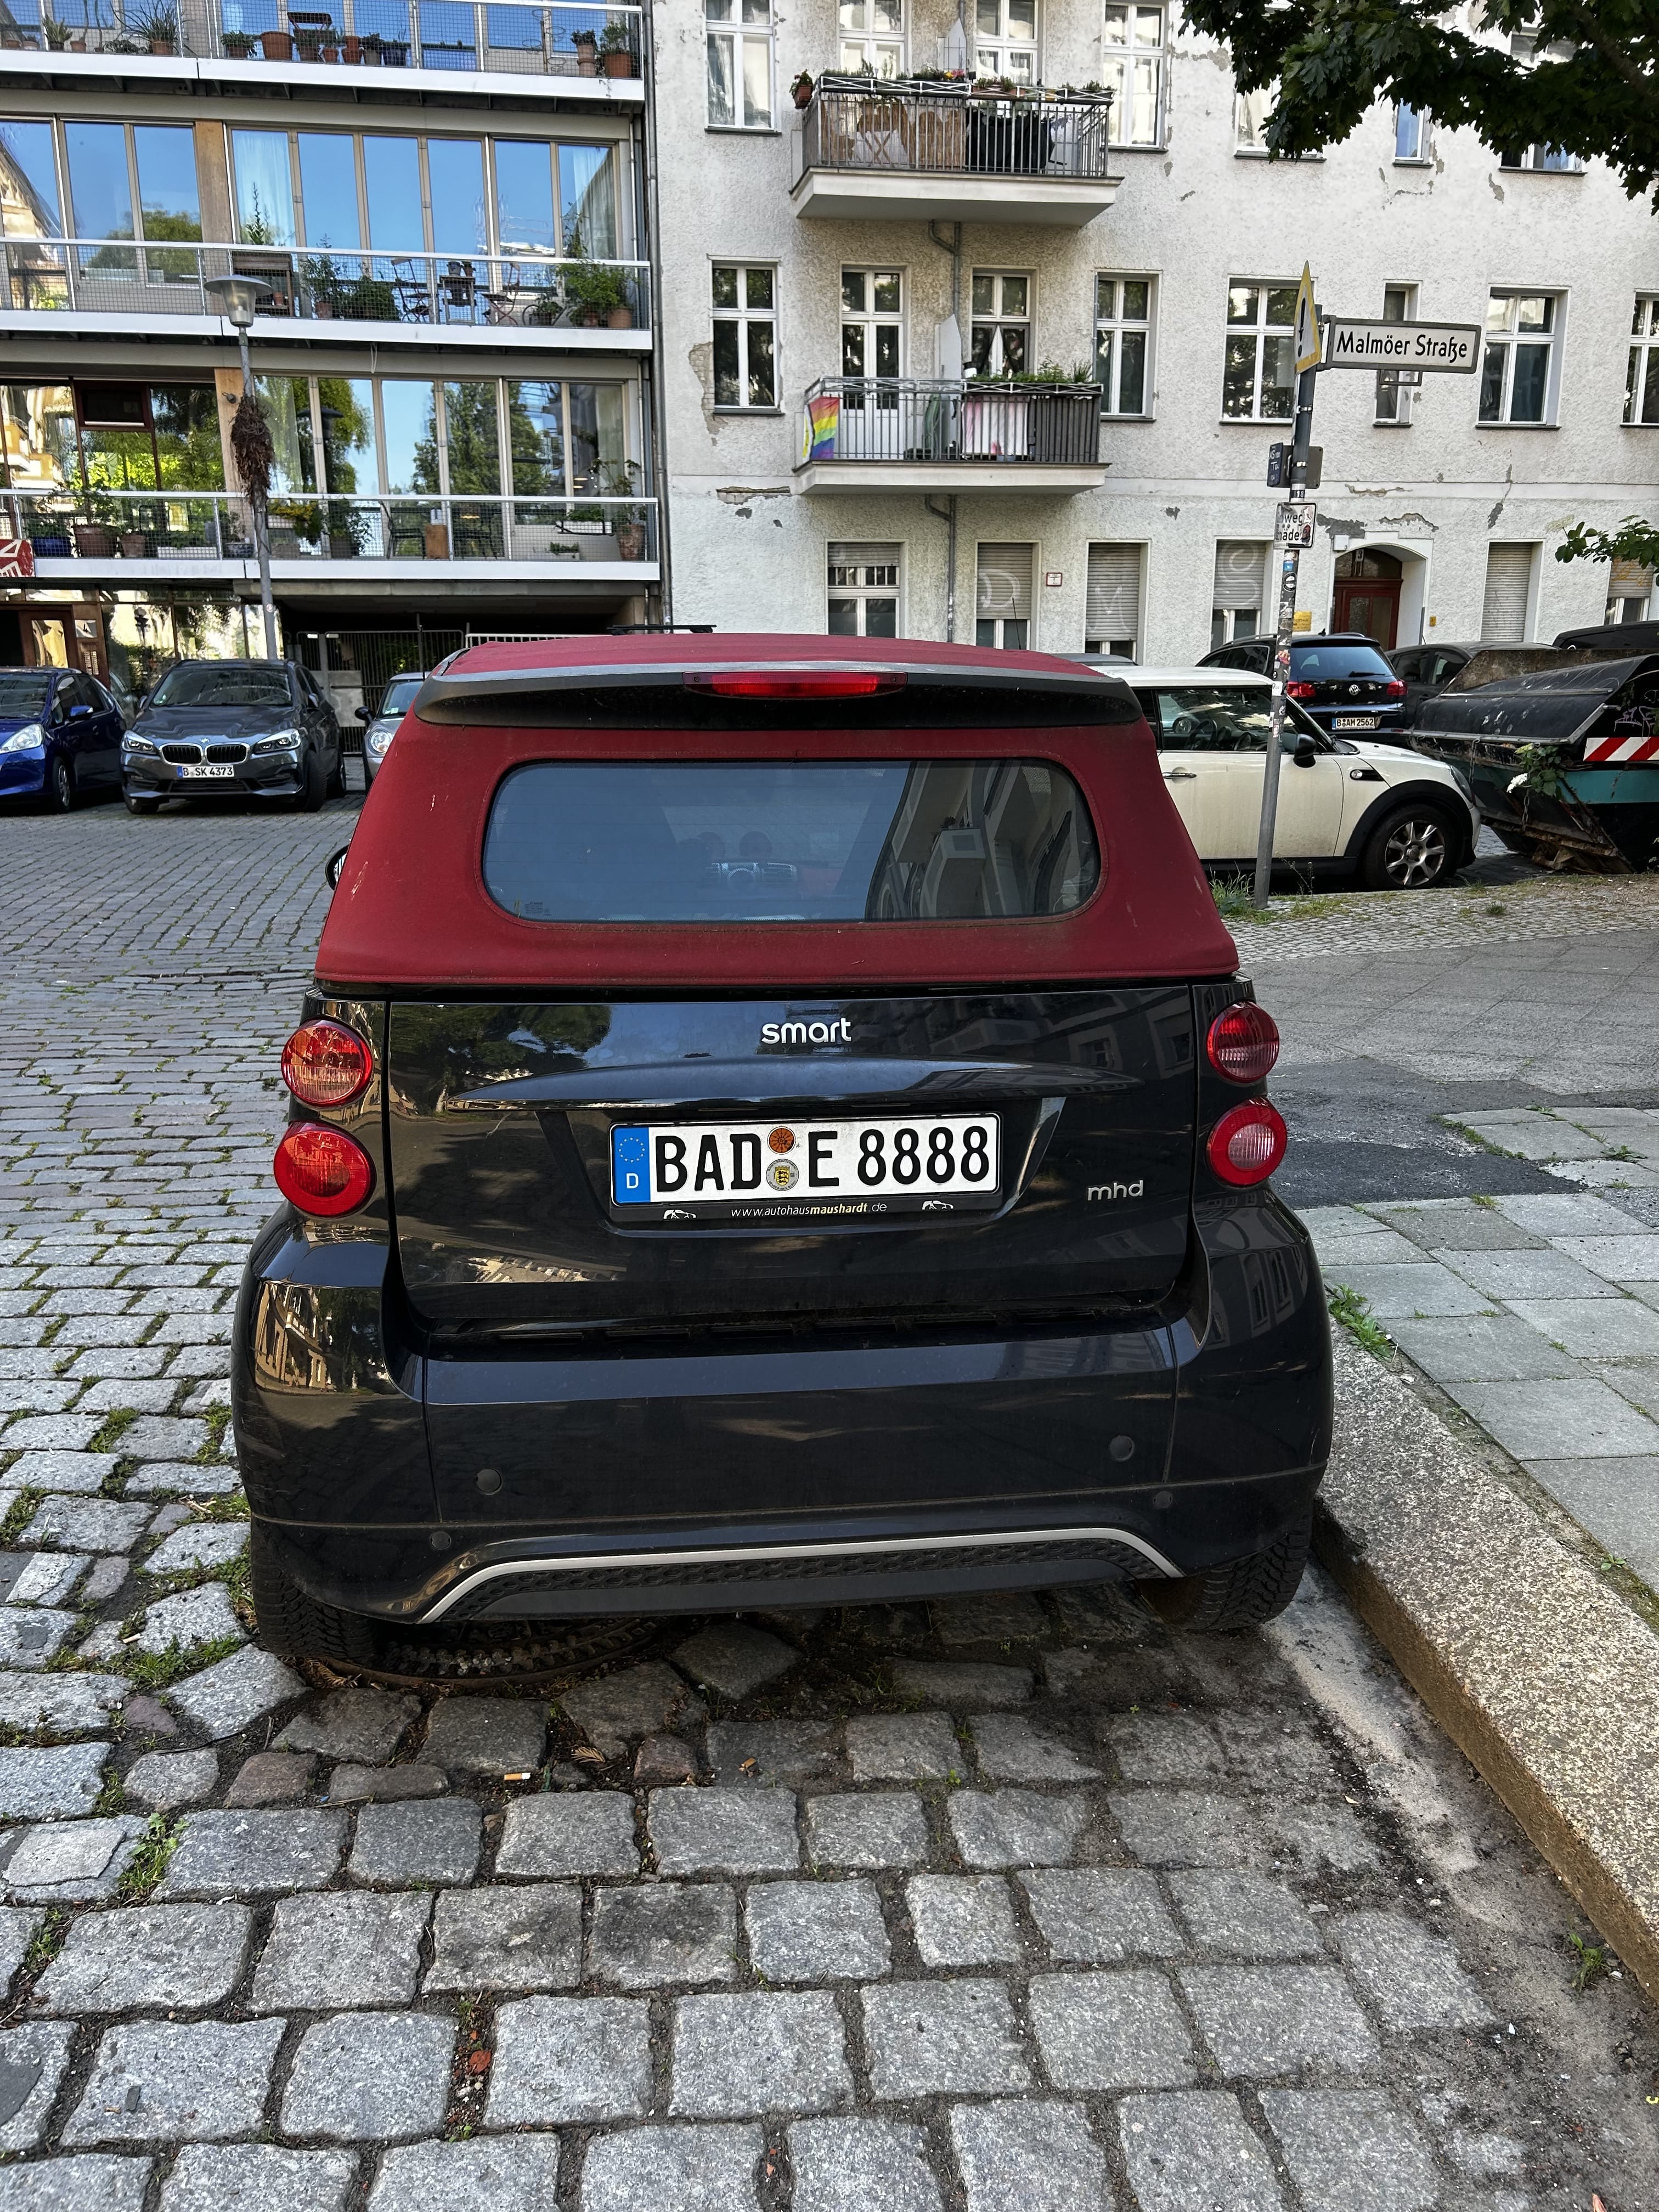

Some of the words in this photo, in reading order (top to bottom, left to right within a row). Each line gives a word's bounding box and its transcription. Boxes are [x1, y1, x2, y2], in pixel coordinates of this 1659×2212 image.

[1336, 331, 1410, 356] Malmöer
[1415, 334, 1468, 363] Straße
[1337, 719, 1341, 727] B
[1357, 718, 1374, 726] 2562
[183, 768, 189, 776] B
[195, 768, 207, 776] SK
[210, 767, 233, 776] 4373
[761, 1018, 851, 1044] smart
[656, 1132, 762, 1192] BAD
[809, 1131, 839, 1187] E
[857, 1126, 989, 1186] 8888
[626, 1173, 639, 1189] D
[1087, 1180, 1143, 1201] mhd
[731, 1203, 887, 1218] www.autohausmaushardt.de
